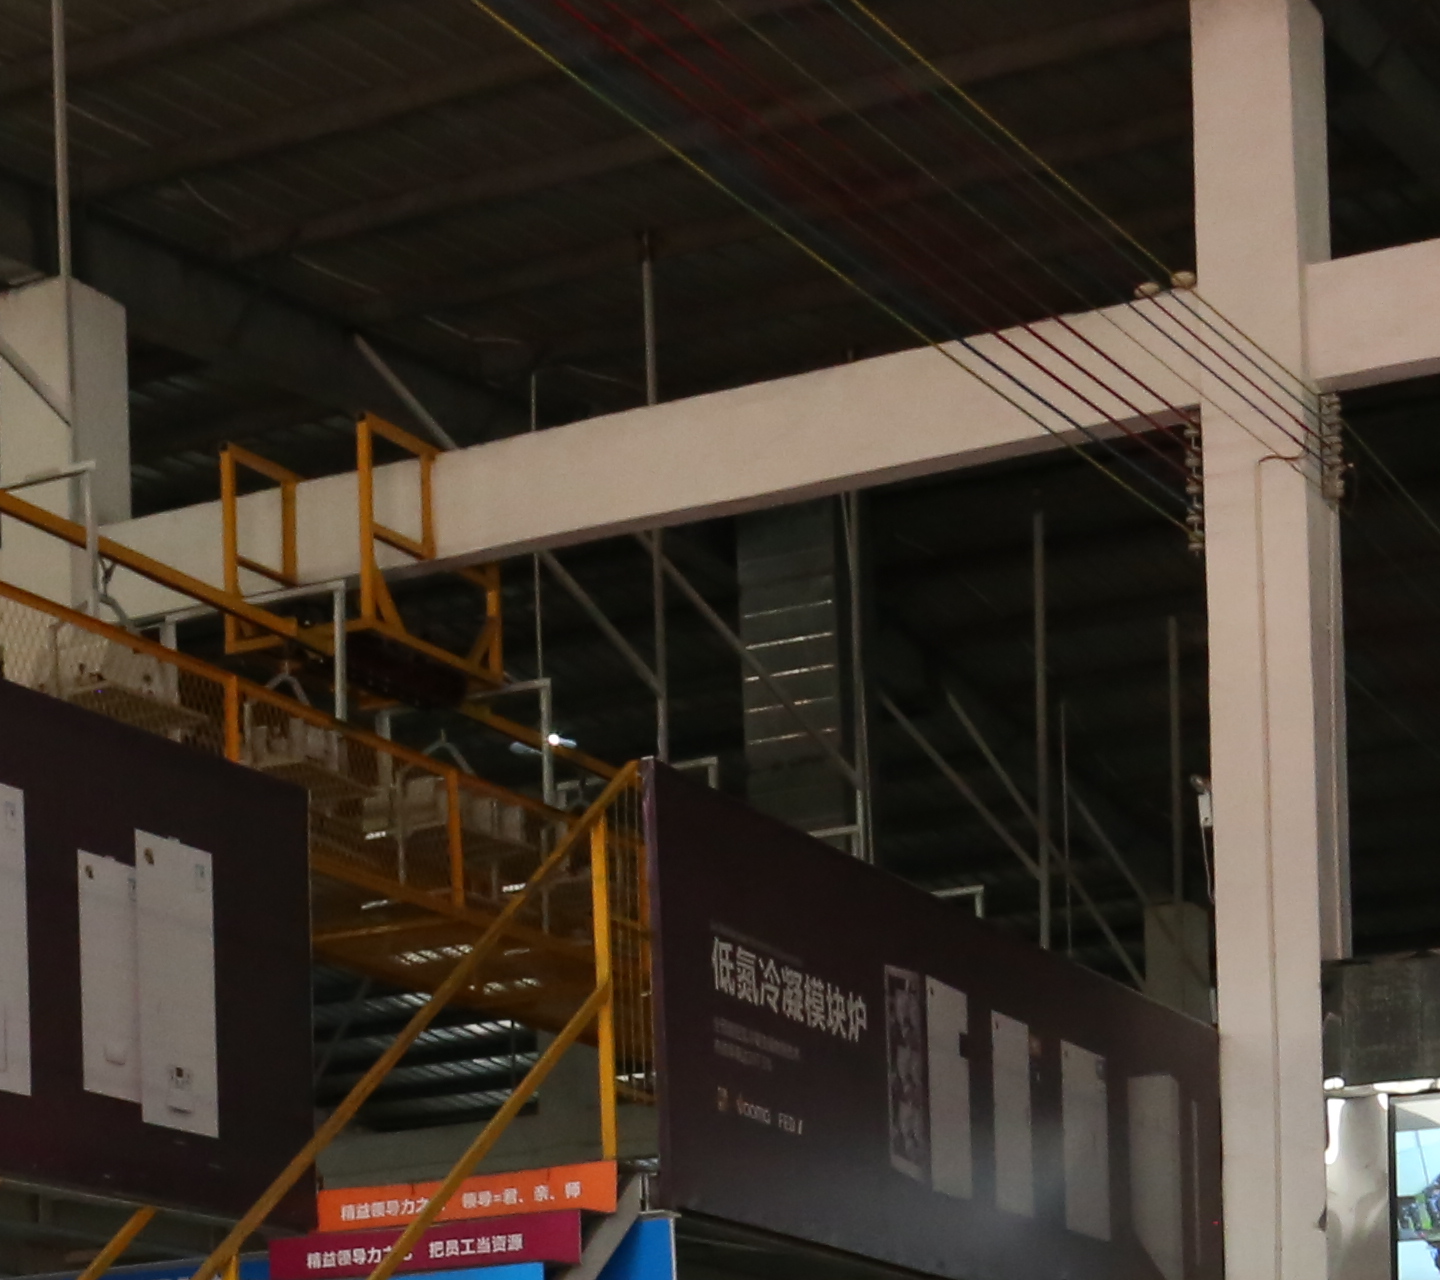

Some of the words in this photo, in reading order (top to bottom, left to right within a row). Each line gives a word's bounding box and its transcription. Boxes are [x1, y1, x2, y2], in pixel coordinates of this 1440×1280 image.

[340, 1197, 446, 1222] 精益领导力之
